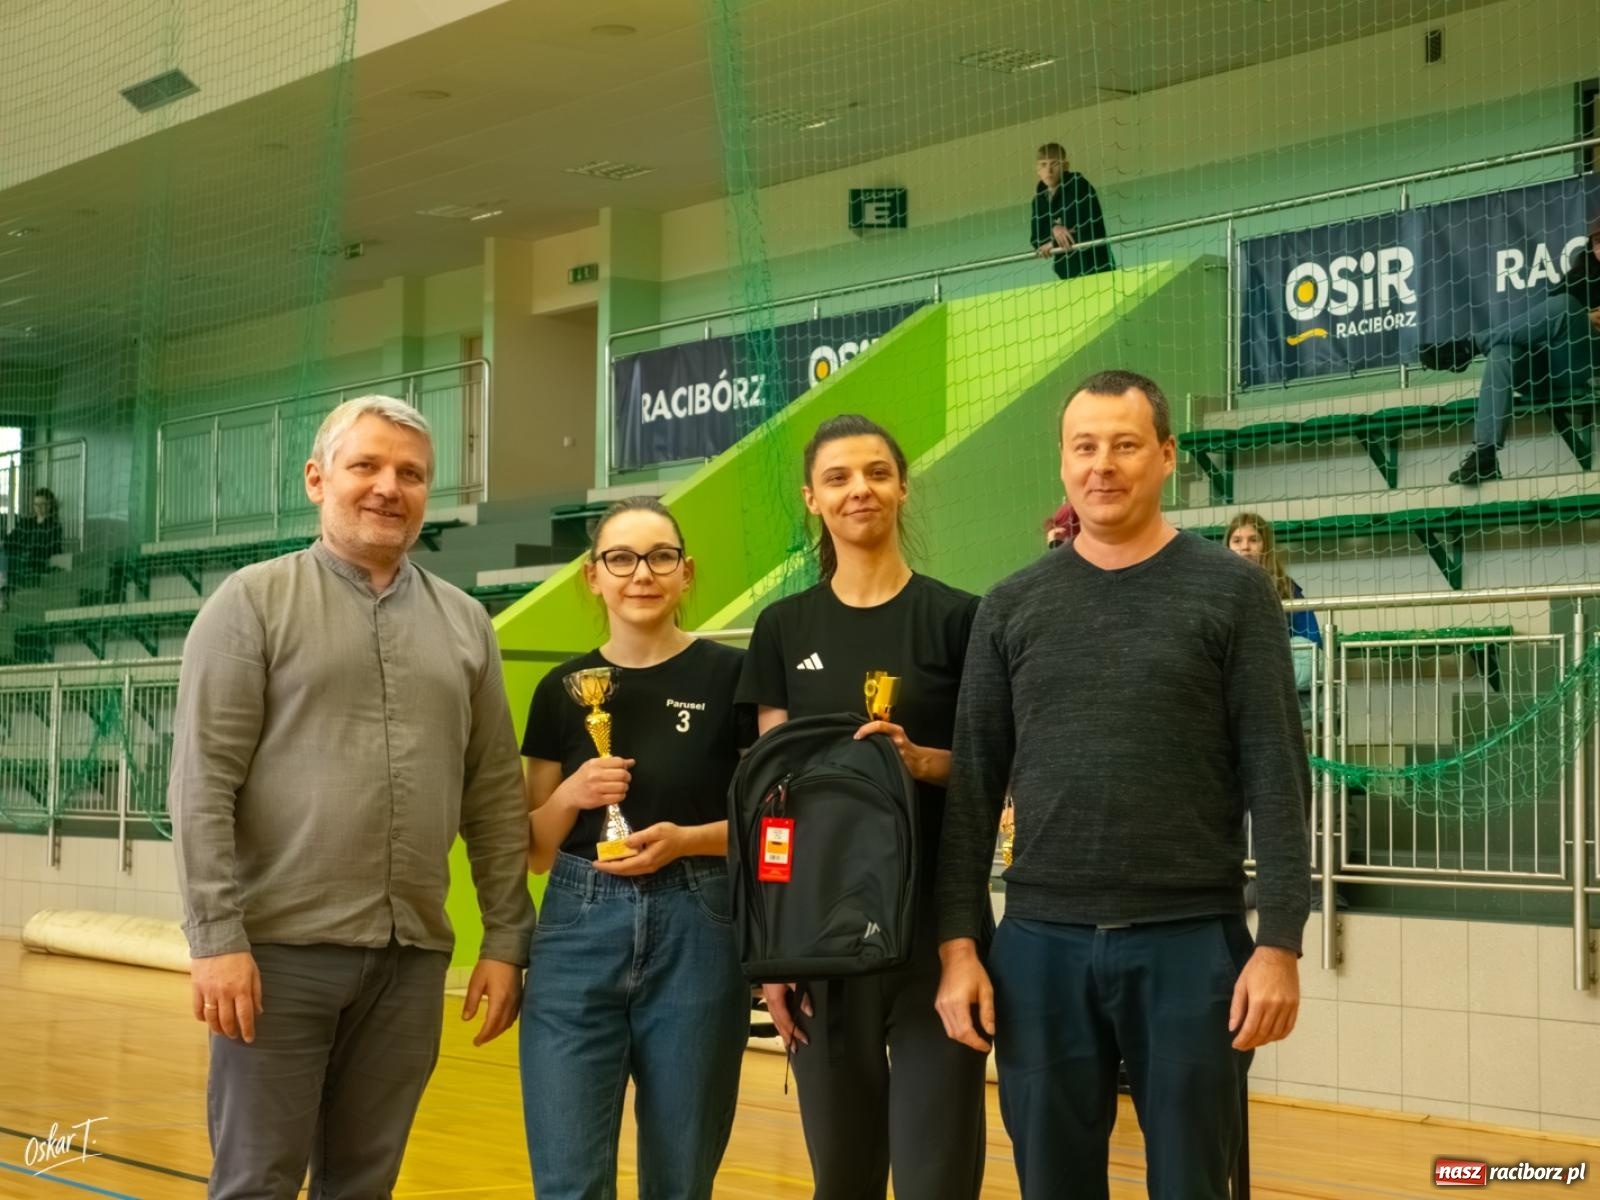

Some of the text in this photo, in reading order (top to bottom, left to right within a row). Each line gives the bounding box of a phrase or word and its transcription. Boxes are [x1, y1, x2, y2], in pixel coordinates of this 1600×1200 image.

[864, 202, 891, 225] E
[1336, 309, 1418, 340] RACIBÓRZ
[641, 368, 767, 425] RACIBÓRZ
[665, 698, 706, 712] Parusel
[675, 709, 691, 733] 3
